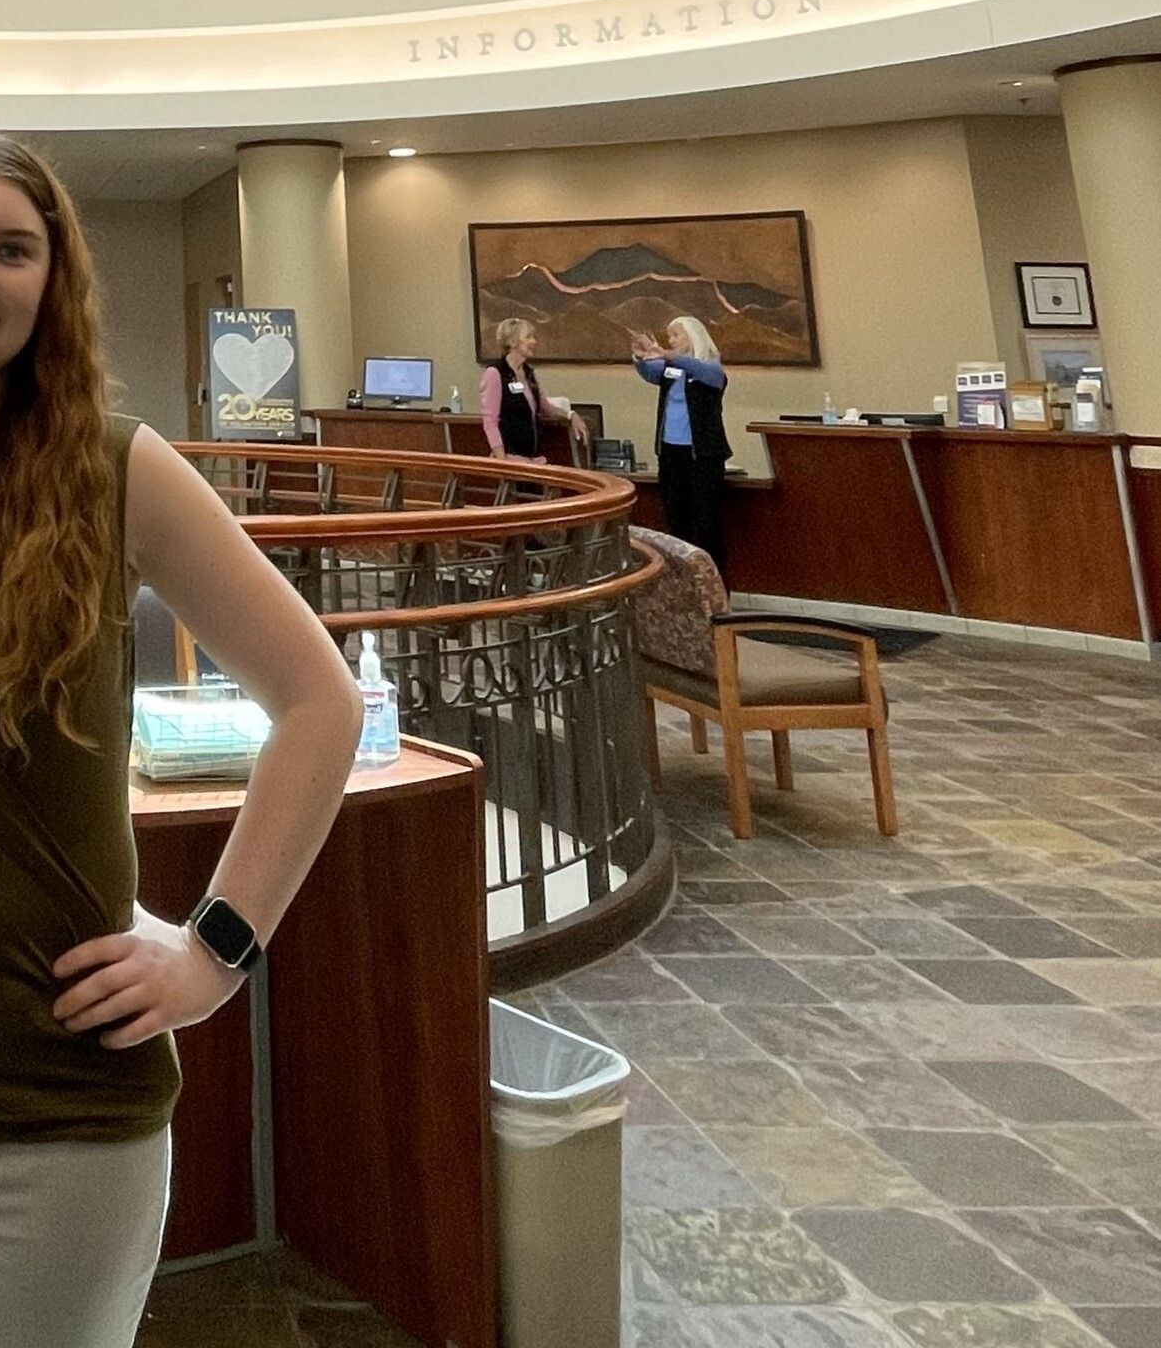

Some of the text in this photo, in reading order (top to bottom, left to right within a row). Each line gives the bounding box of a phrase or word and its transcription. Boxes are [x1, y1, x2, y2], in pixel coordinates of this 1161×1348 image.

[214, 311, 272, 324] THANK
[251, 324, 292, 338] YOU!
[217, 393, 296, 422] 20 YEARS
